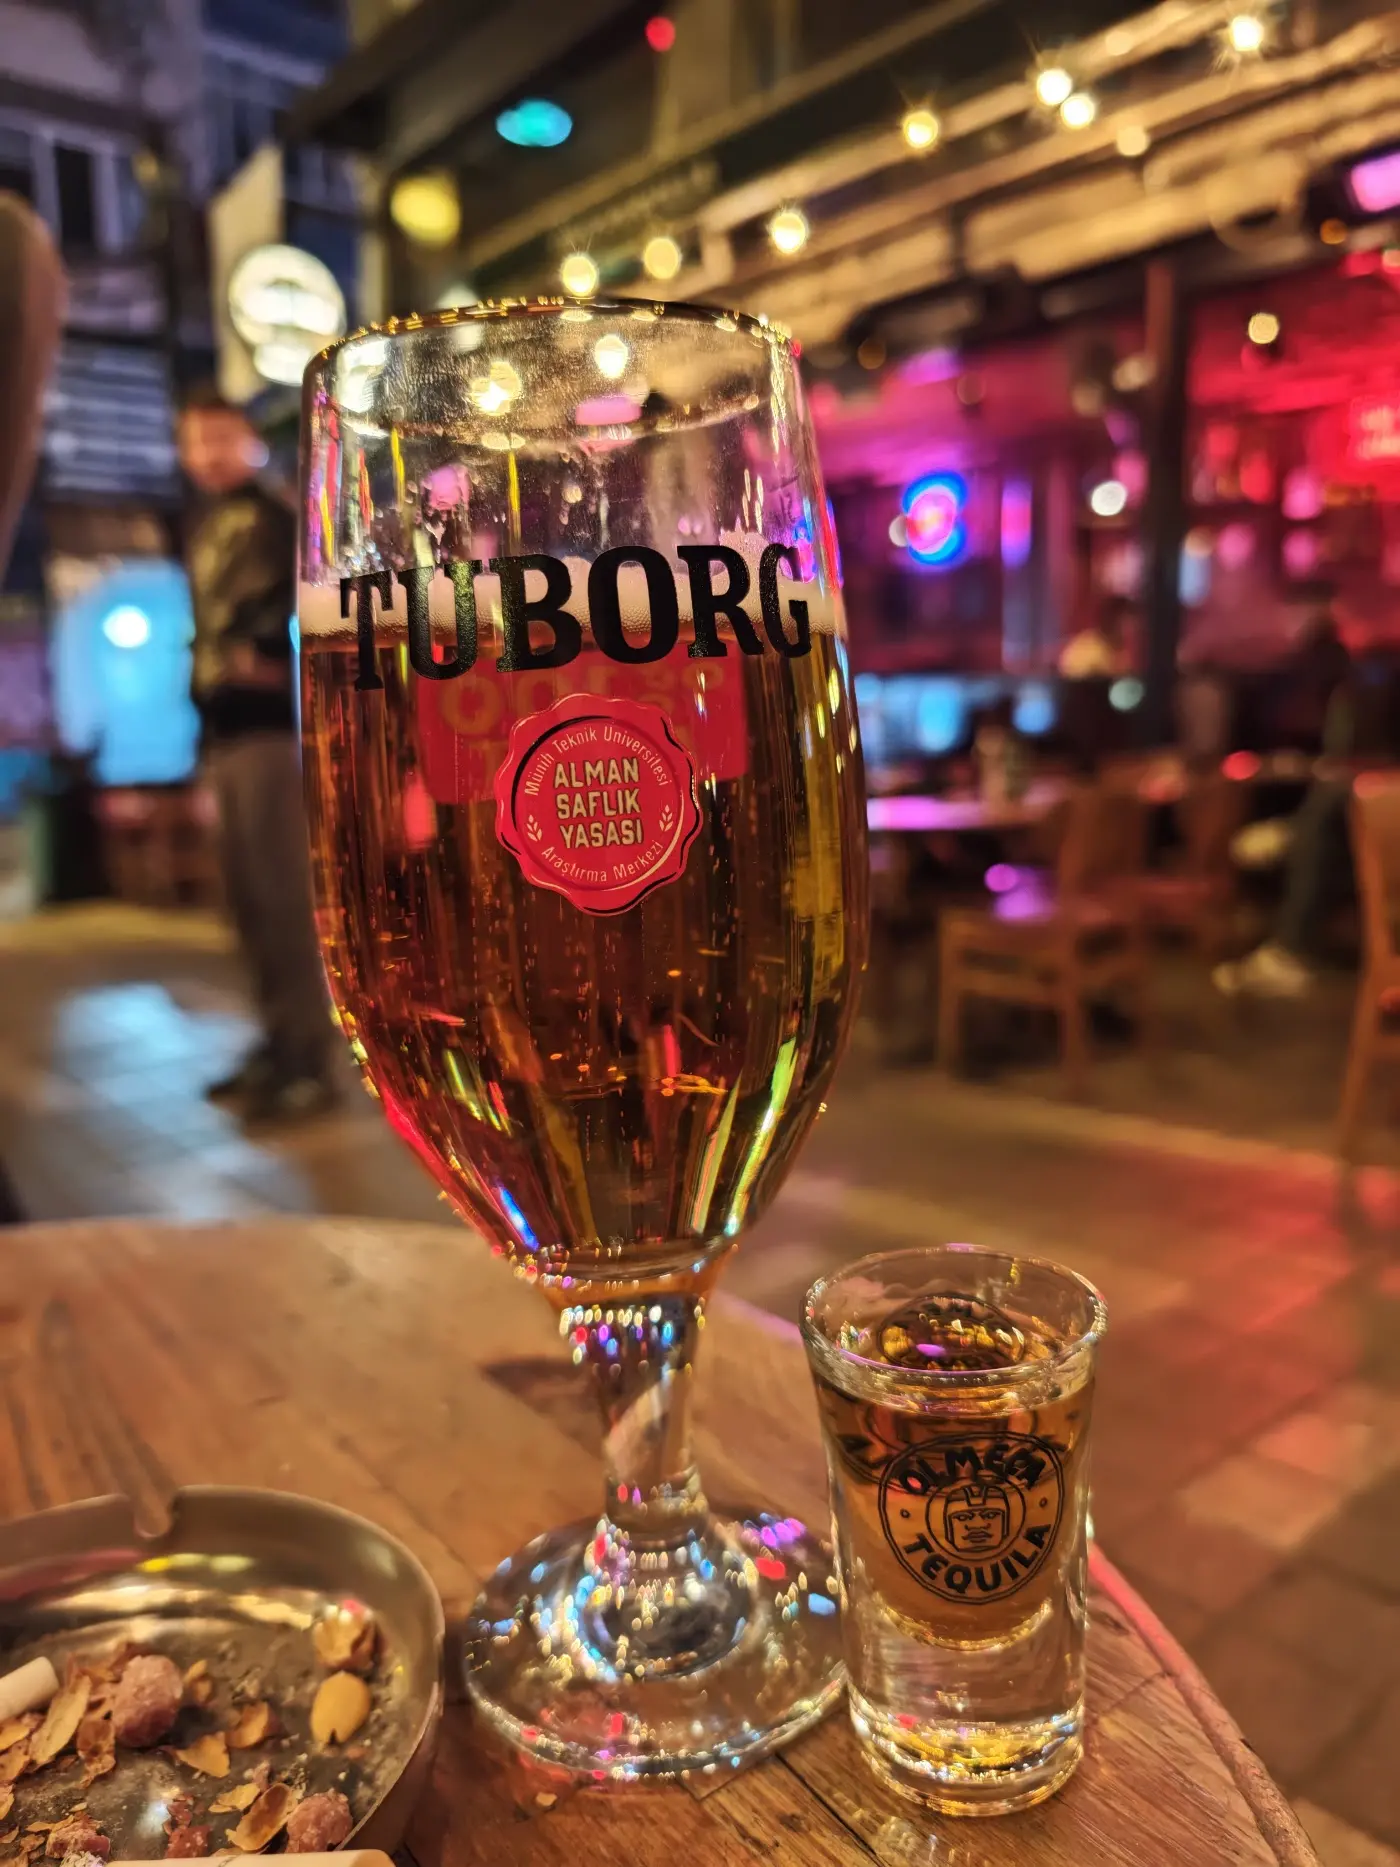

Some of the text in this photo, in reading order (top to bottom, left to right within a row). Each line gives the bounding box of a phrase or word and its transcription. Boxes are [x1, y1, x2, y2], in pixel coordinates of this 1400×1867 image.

[340, 543, 811, 691] TUBORG
[524, 752, 555, 796] Münih
[552, 726, 598, 753] Teknik
[554, 757, 640, 788] ALMAN
[556, 788, 641, 819] SAFLIK
[560, 819, 643, 848] YASASI
[541, 840, 664, 882] Araştırma Merkezi
[901, 1444, 1046, 1494] OLMECA
[904, 1524, 1051, 1594] TEQUILA
